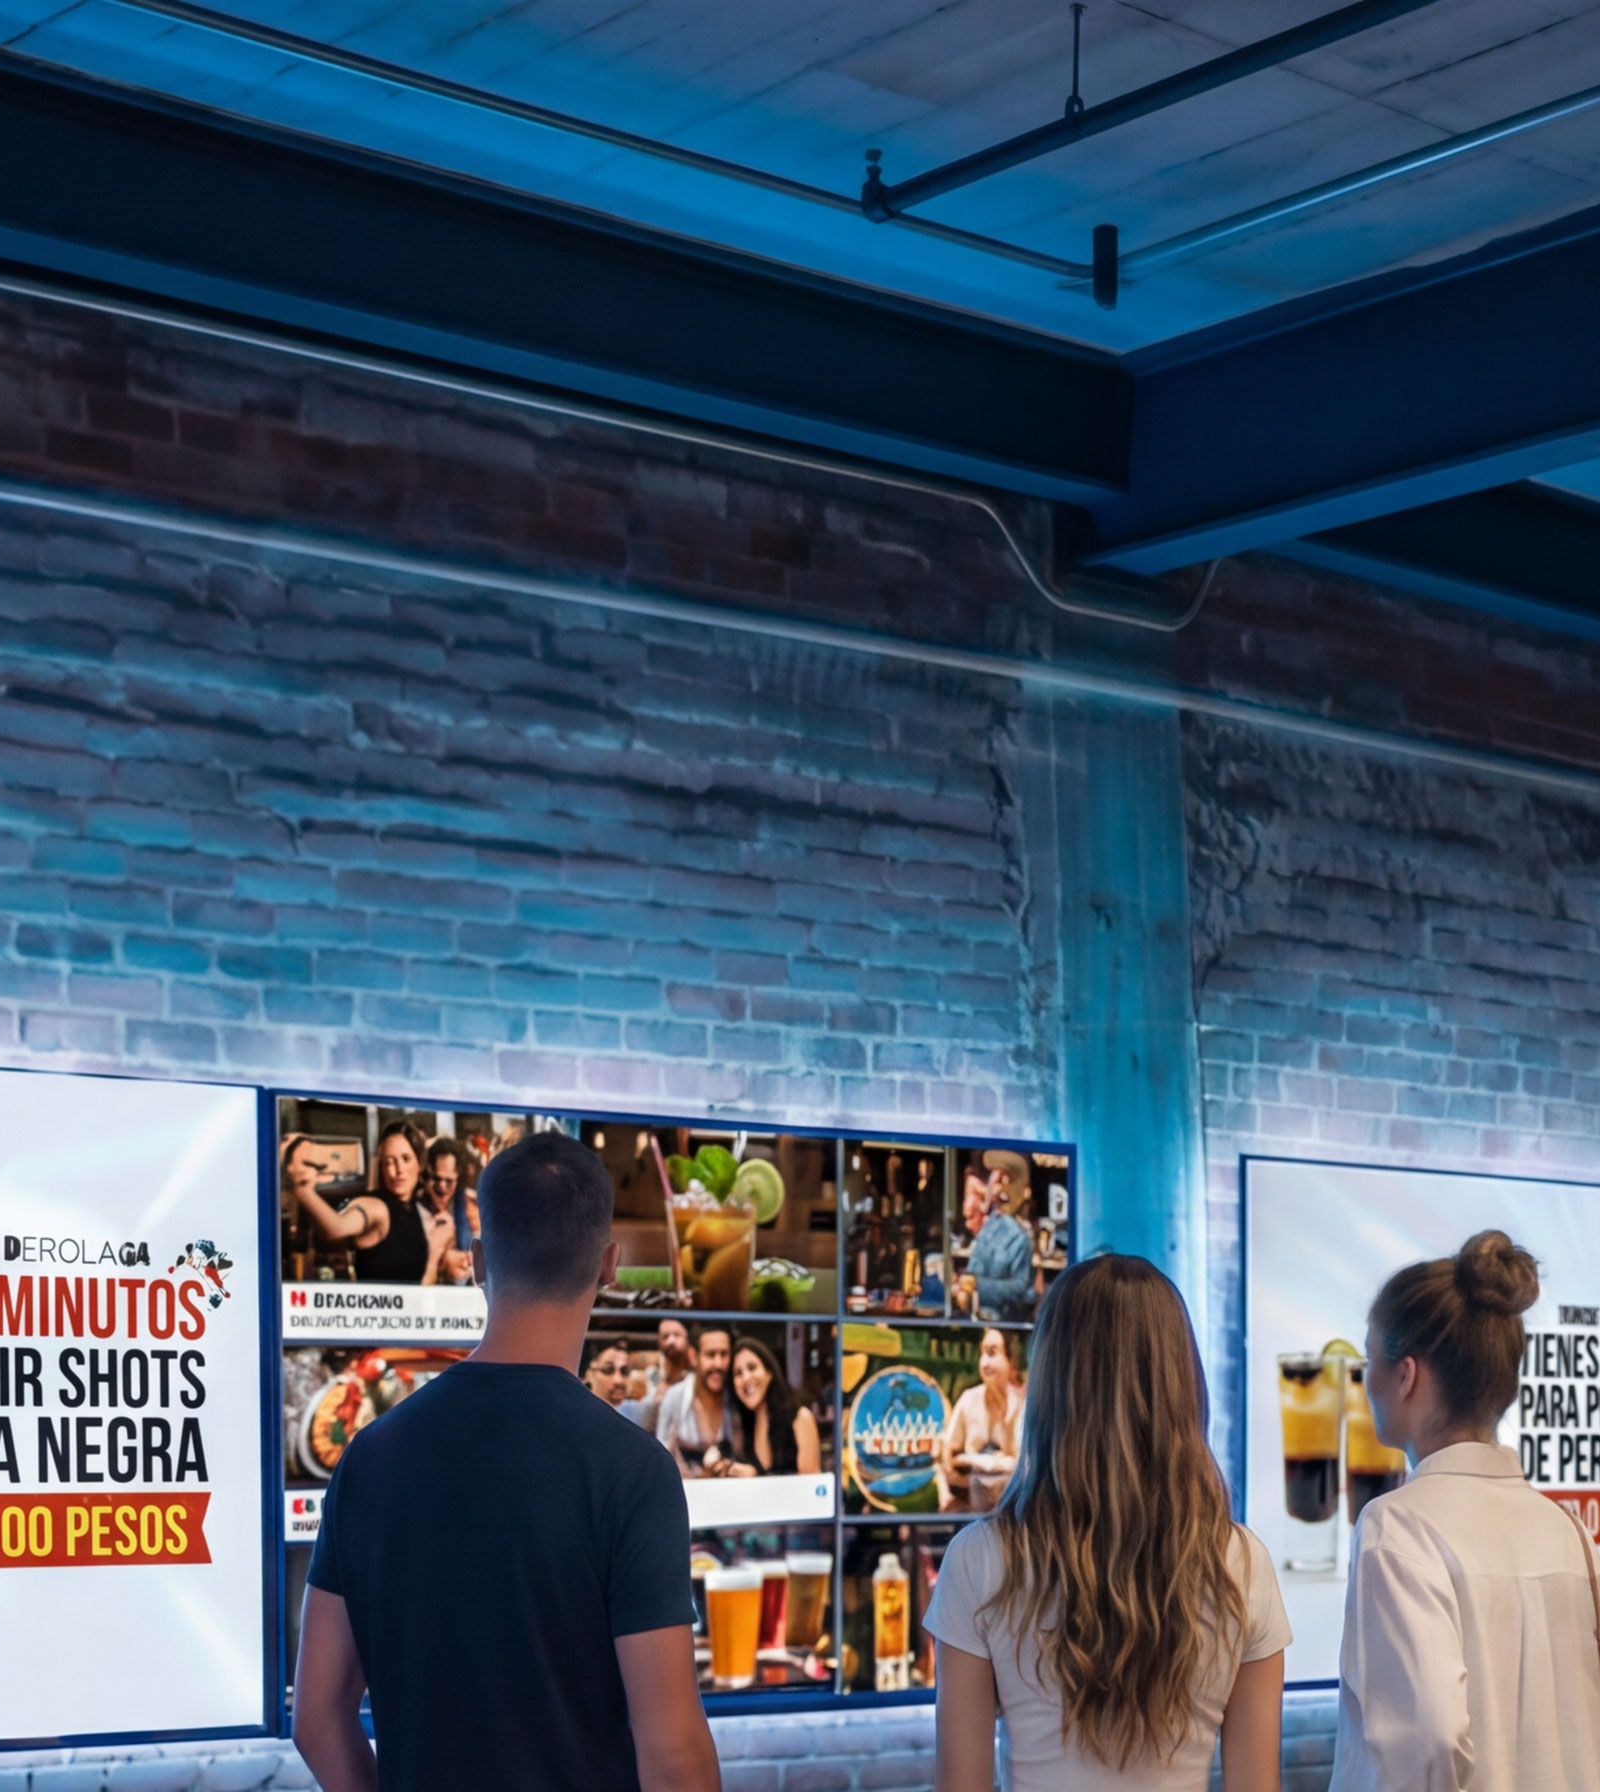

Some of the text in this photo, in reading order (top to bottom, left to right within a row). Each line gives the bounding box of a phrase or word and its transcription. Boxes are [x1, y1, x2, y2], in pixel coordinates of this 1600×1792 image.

[58, 1347, 206, 1410] SHOTS
[1522, 1333, 1600, 1379] TIENES
[1519, 1383, 1580, 1429] PARA
[37, 1416, 209, 1484] NEGRA
[1520, 1433, 1551, 1482] DE
[66, 1504, 188, 1557] PESOS
